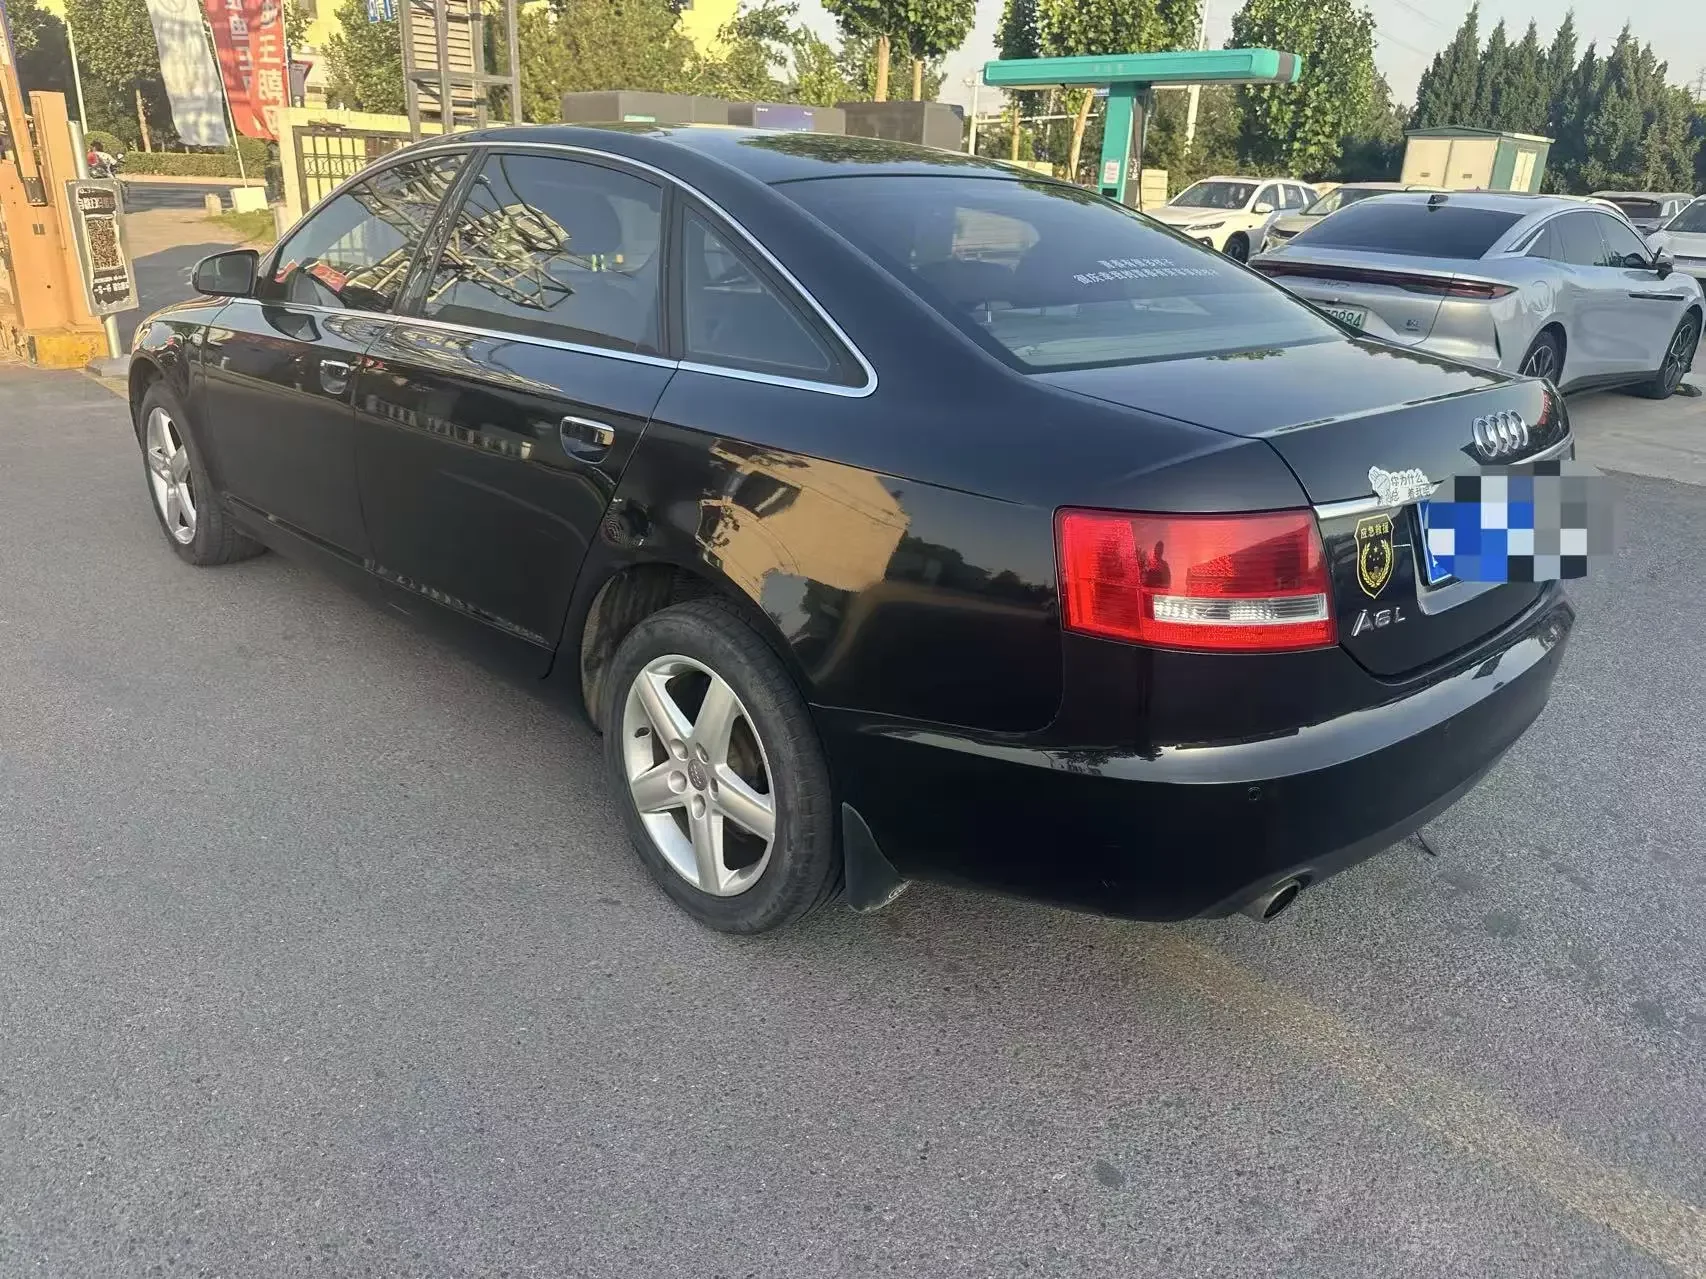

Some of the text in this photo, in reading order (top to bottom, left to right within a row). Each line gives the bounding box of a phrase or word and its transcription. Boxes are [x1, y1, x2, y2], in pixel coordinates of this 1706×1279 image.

[1391, 475, 1423, 488] 你为什么
[1360, 522, 1389, 539] 应急救援
[1351, 607, 1406, 636] A6L
